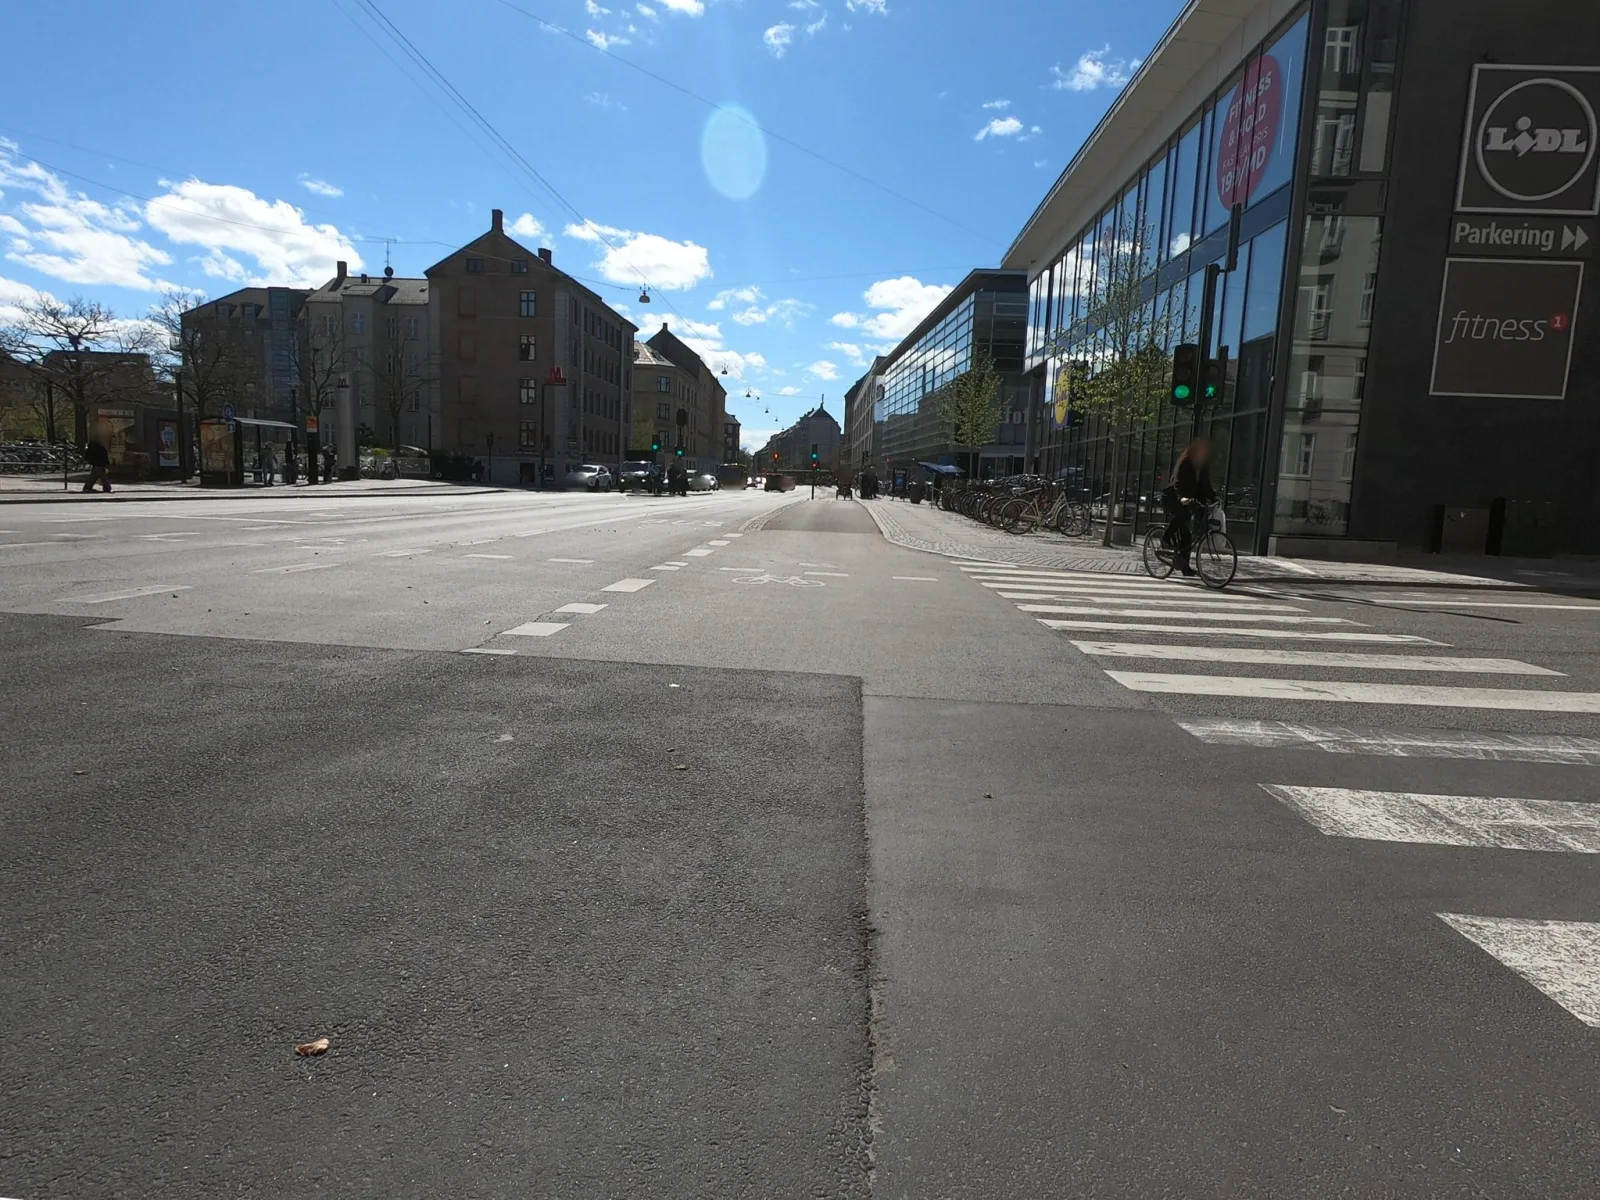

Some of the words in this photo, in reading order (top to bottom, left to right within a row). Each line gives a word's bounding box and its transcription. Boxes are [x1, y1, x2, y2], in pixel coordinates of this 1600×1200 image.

[1229, 71, 1272, 123] FITNESS
[1228, 129, 1236, 147] &
[1236, 102, 1267, 140] HOLD
[1454, 221, 1555, 252] Parkering
[1444, 310, 1549, 343] fitness
